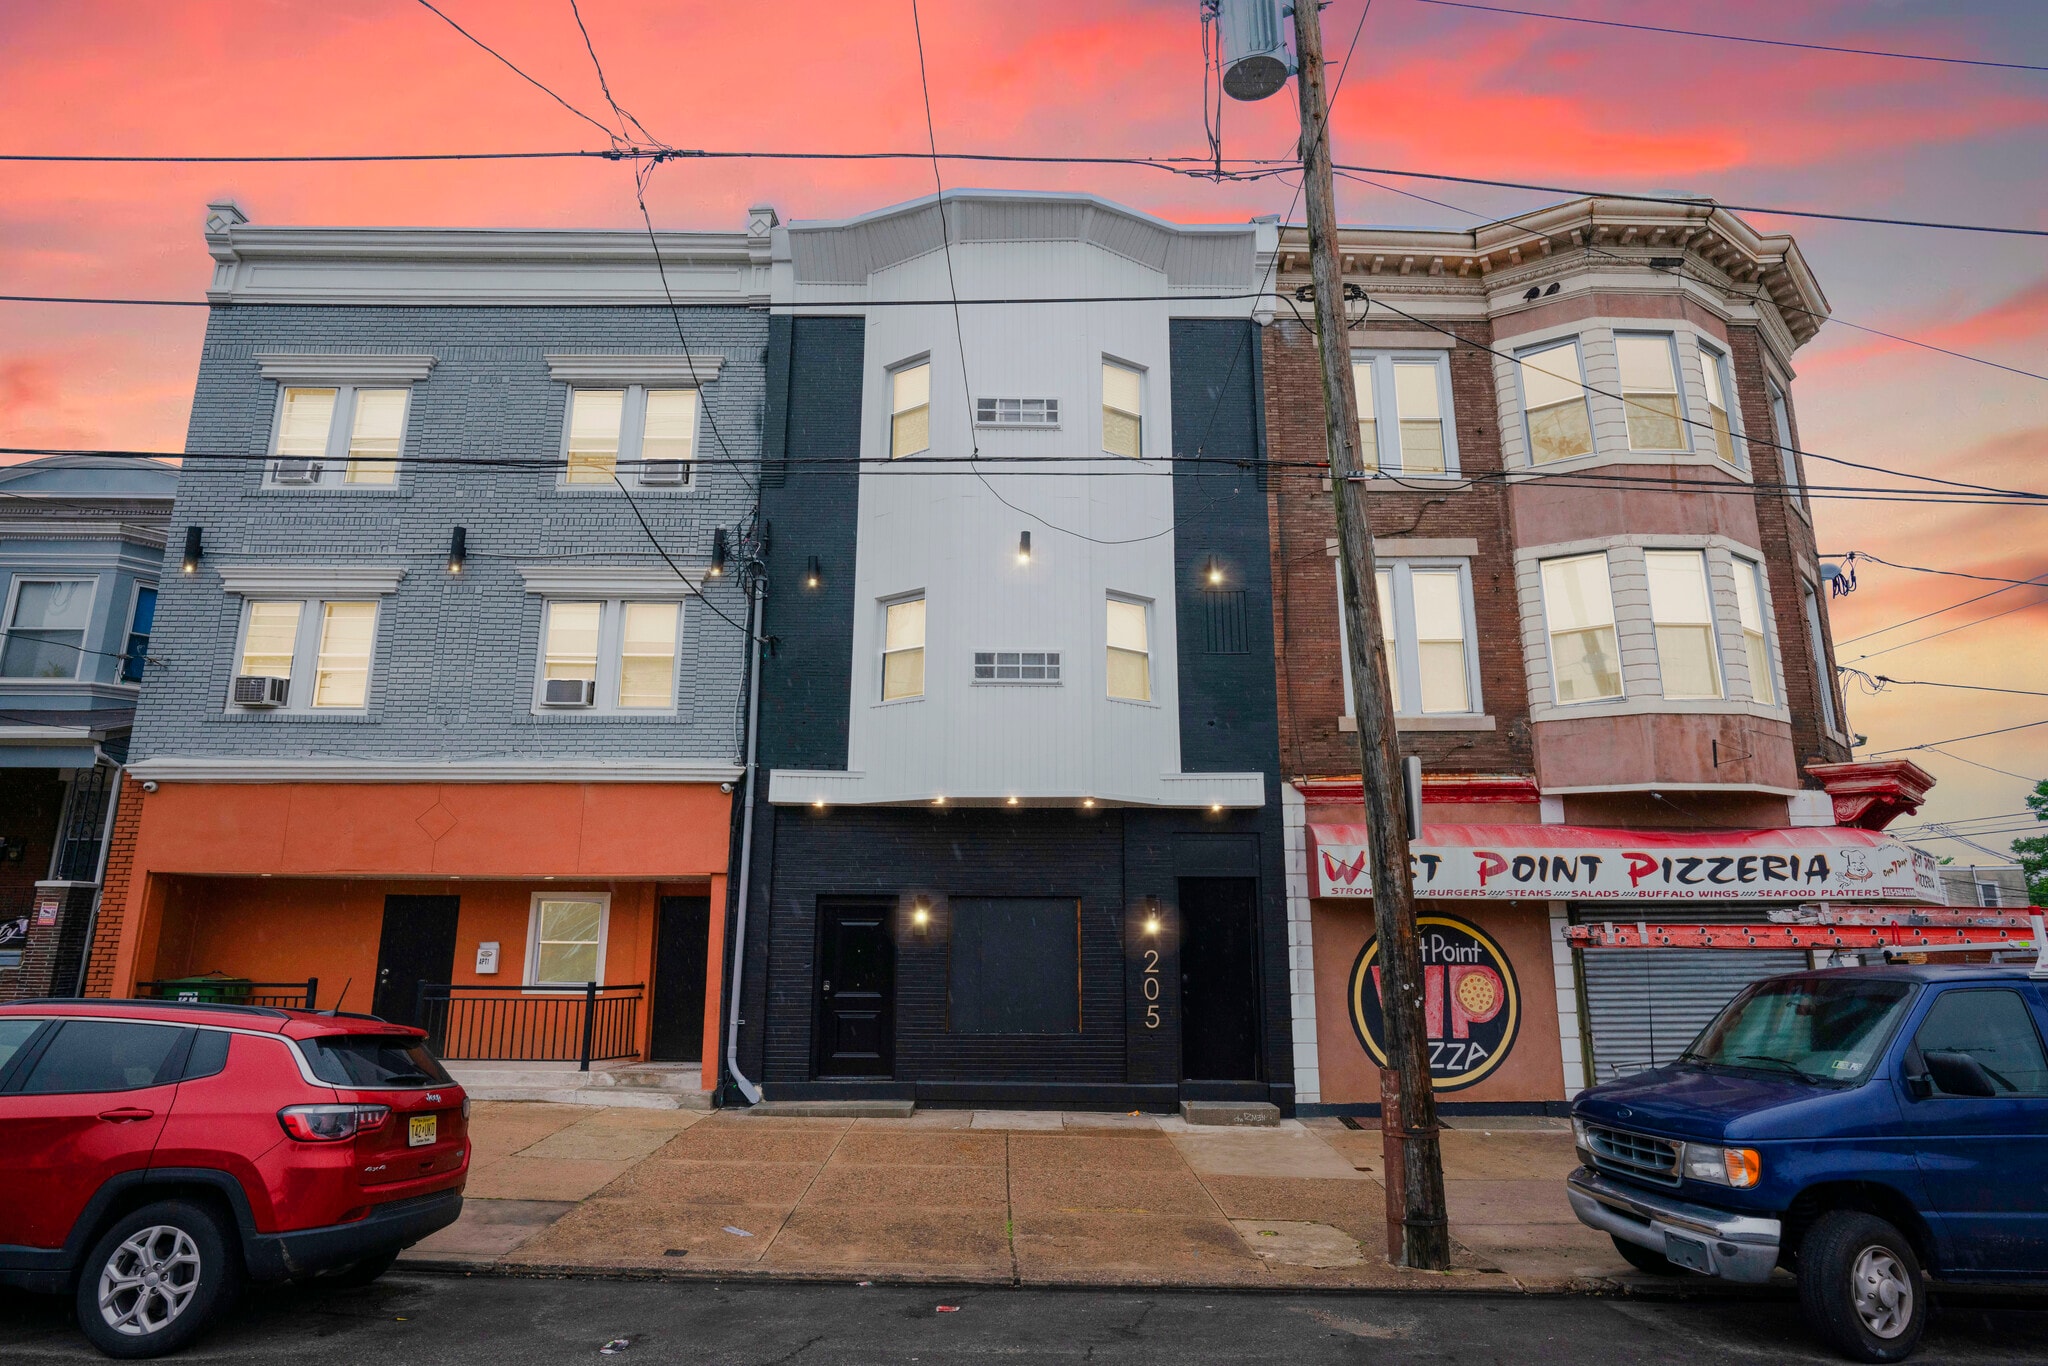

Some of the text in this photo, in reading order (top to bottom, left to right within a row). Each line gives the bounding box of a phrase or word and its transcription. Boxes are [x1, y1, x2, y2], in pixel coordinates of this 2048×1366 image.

[1322, 850, 1831, 889] WT POINT PIZZERIA
[1890, 860, 1898, 876] 7
[1429, 889, 1487, 897] BURGERS
[1506, 889, 1552, 897] STEAKS
[1571, 890, 1619, 898] SALADS
[1638, 890, 1694, 898] BUFFALO
[1698, 890, 1739, 898] WINGS
[1758, 889, 1816, 898] SEAFOOD
[1821, 889, 1880, 897] PLATTERS
[1431, 933, 1483, 963] Point
[1143, 949, 1160, 1029] 205
[1427, 1041, 1489, 1070] ZZA
[426, 1093, 441, 1102] Jeep
[364, 1164, 387, 1172] 4x4
